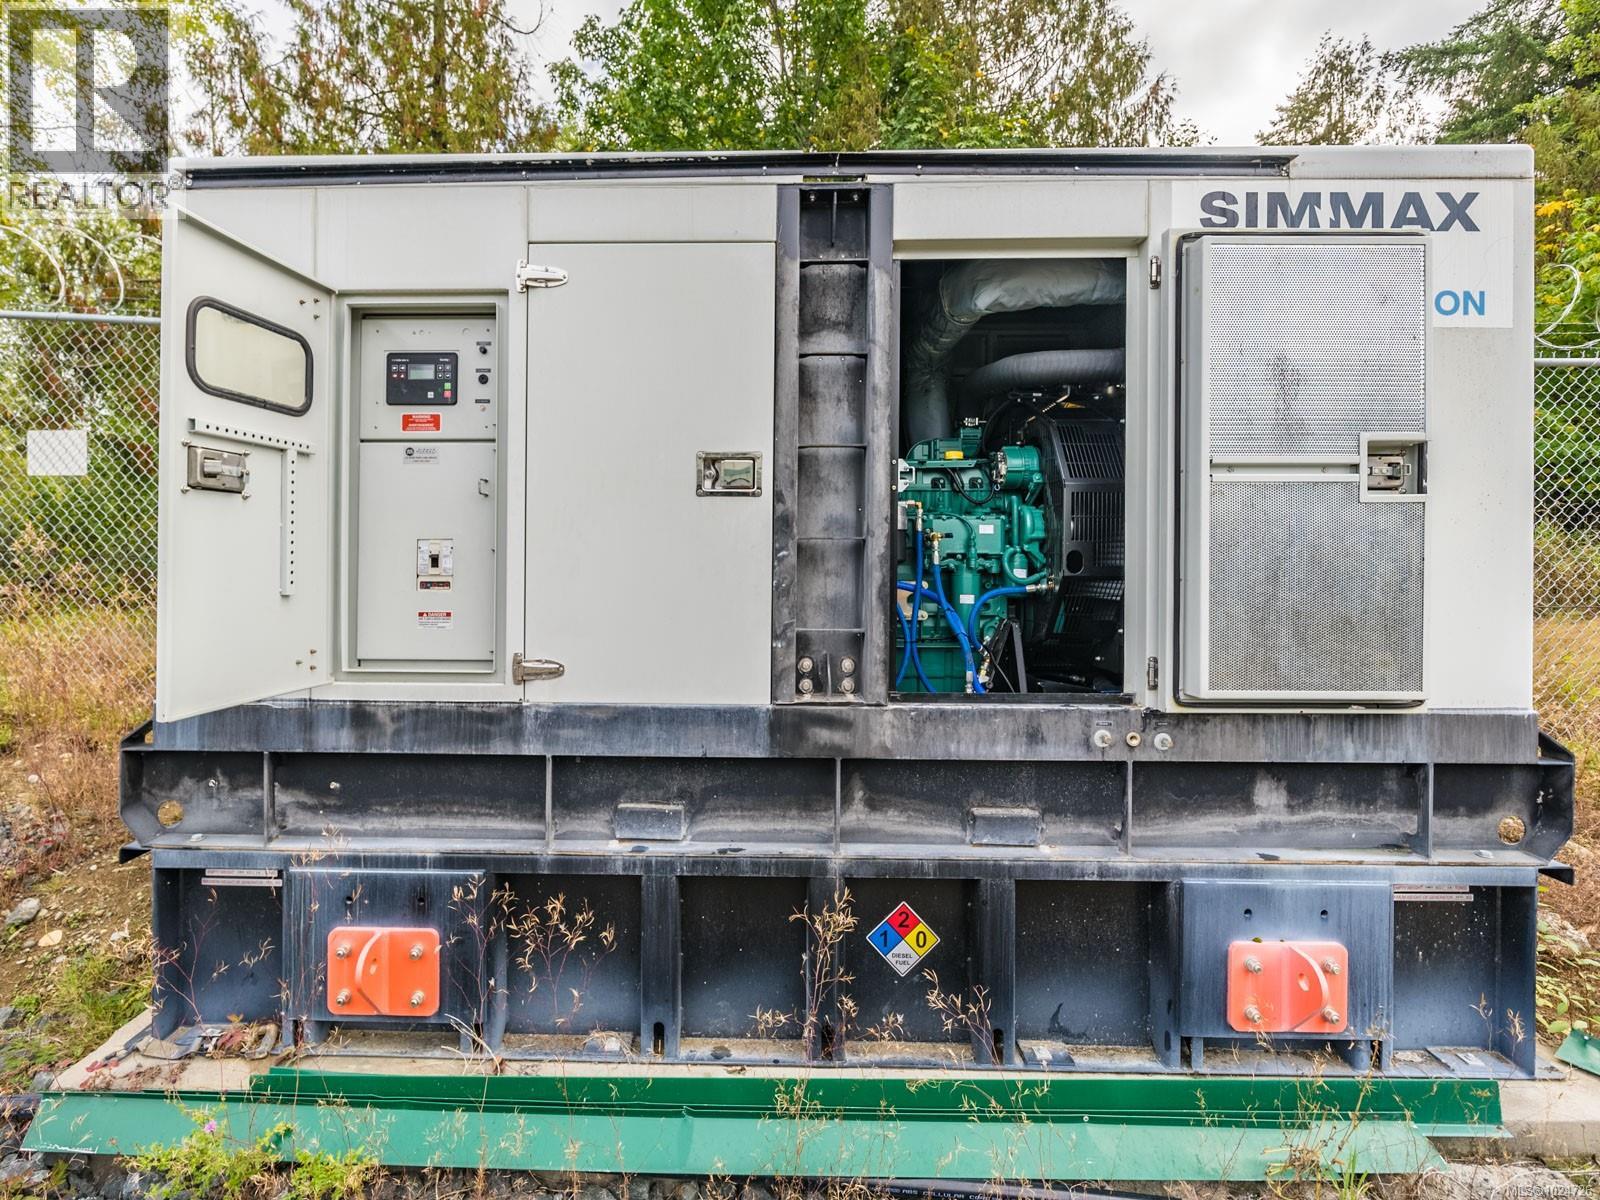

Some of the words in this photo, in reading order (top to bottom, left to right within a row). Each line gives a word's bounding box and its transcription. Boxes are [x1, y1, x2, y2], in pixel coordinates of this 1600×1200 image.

[1199, 191, 1480, 232] SIMMAX
[898, 911, 909, 928] 2
[880, 930, 888, 947] 1
[916, 931, 927, 948] 0
